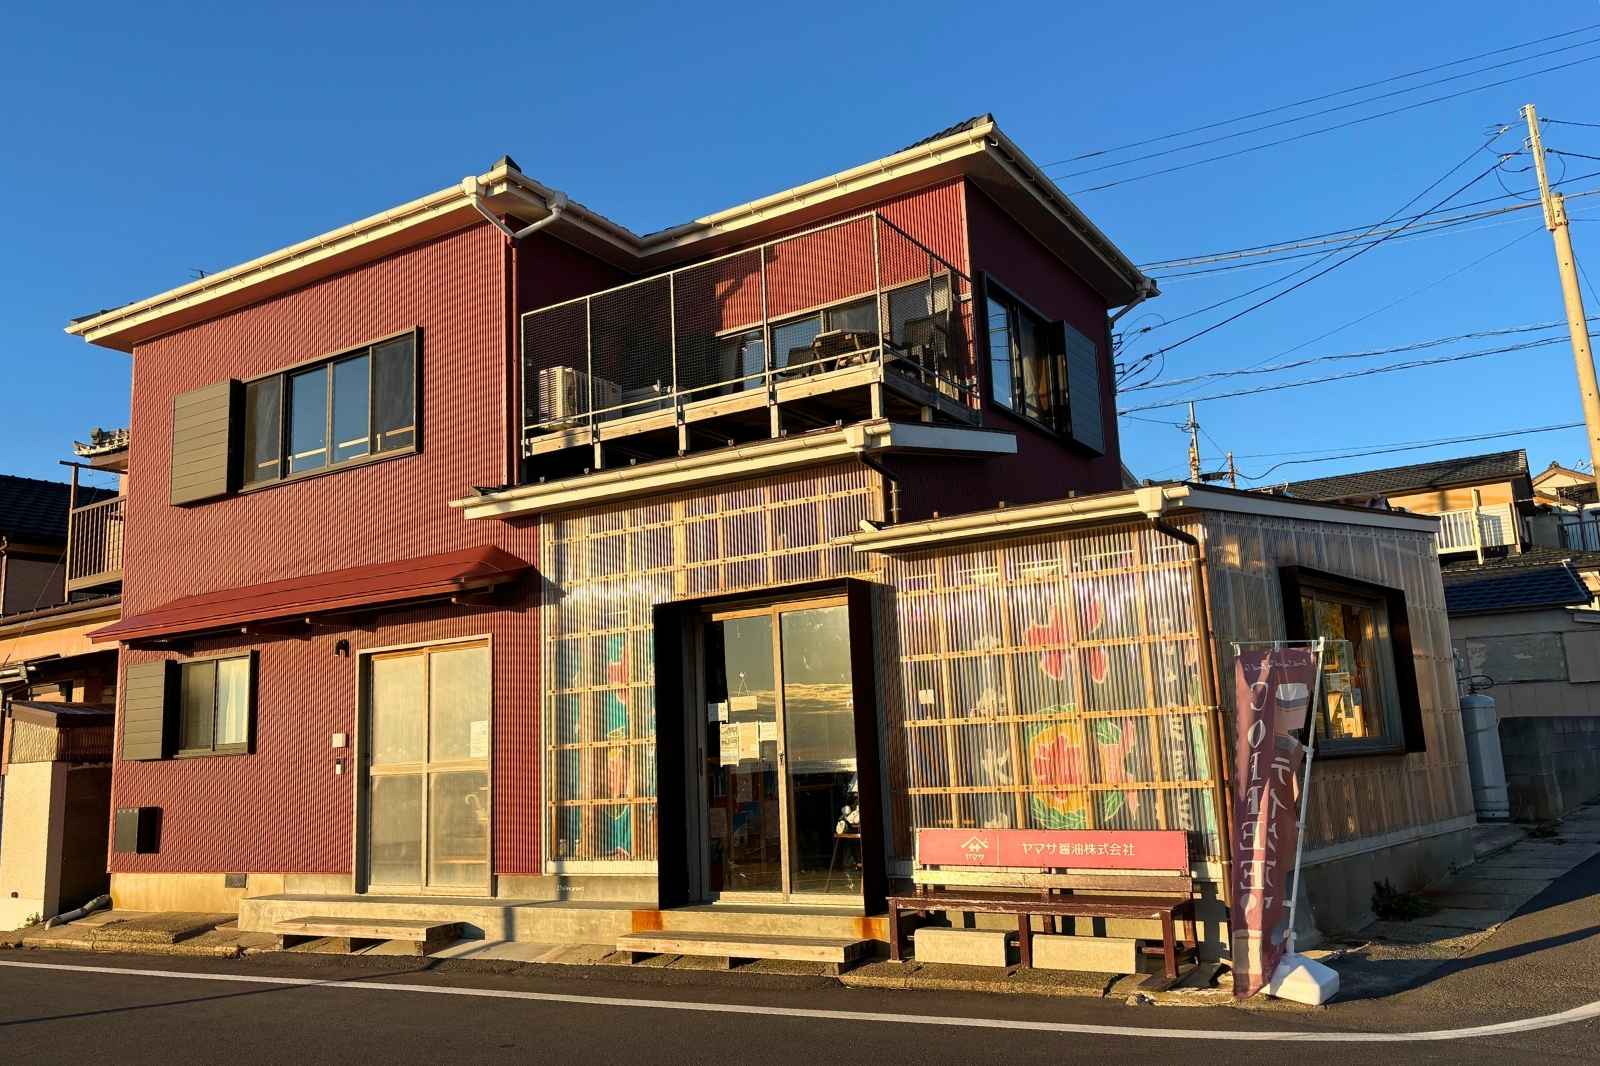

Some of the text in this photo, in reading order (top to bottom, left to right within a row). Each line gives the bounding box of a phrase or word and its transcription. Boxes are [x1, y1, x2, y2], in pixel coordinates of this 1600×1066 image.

[1022, 842, 1136, 857] ヤマサ醤油株式会社
